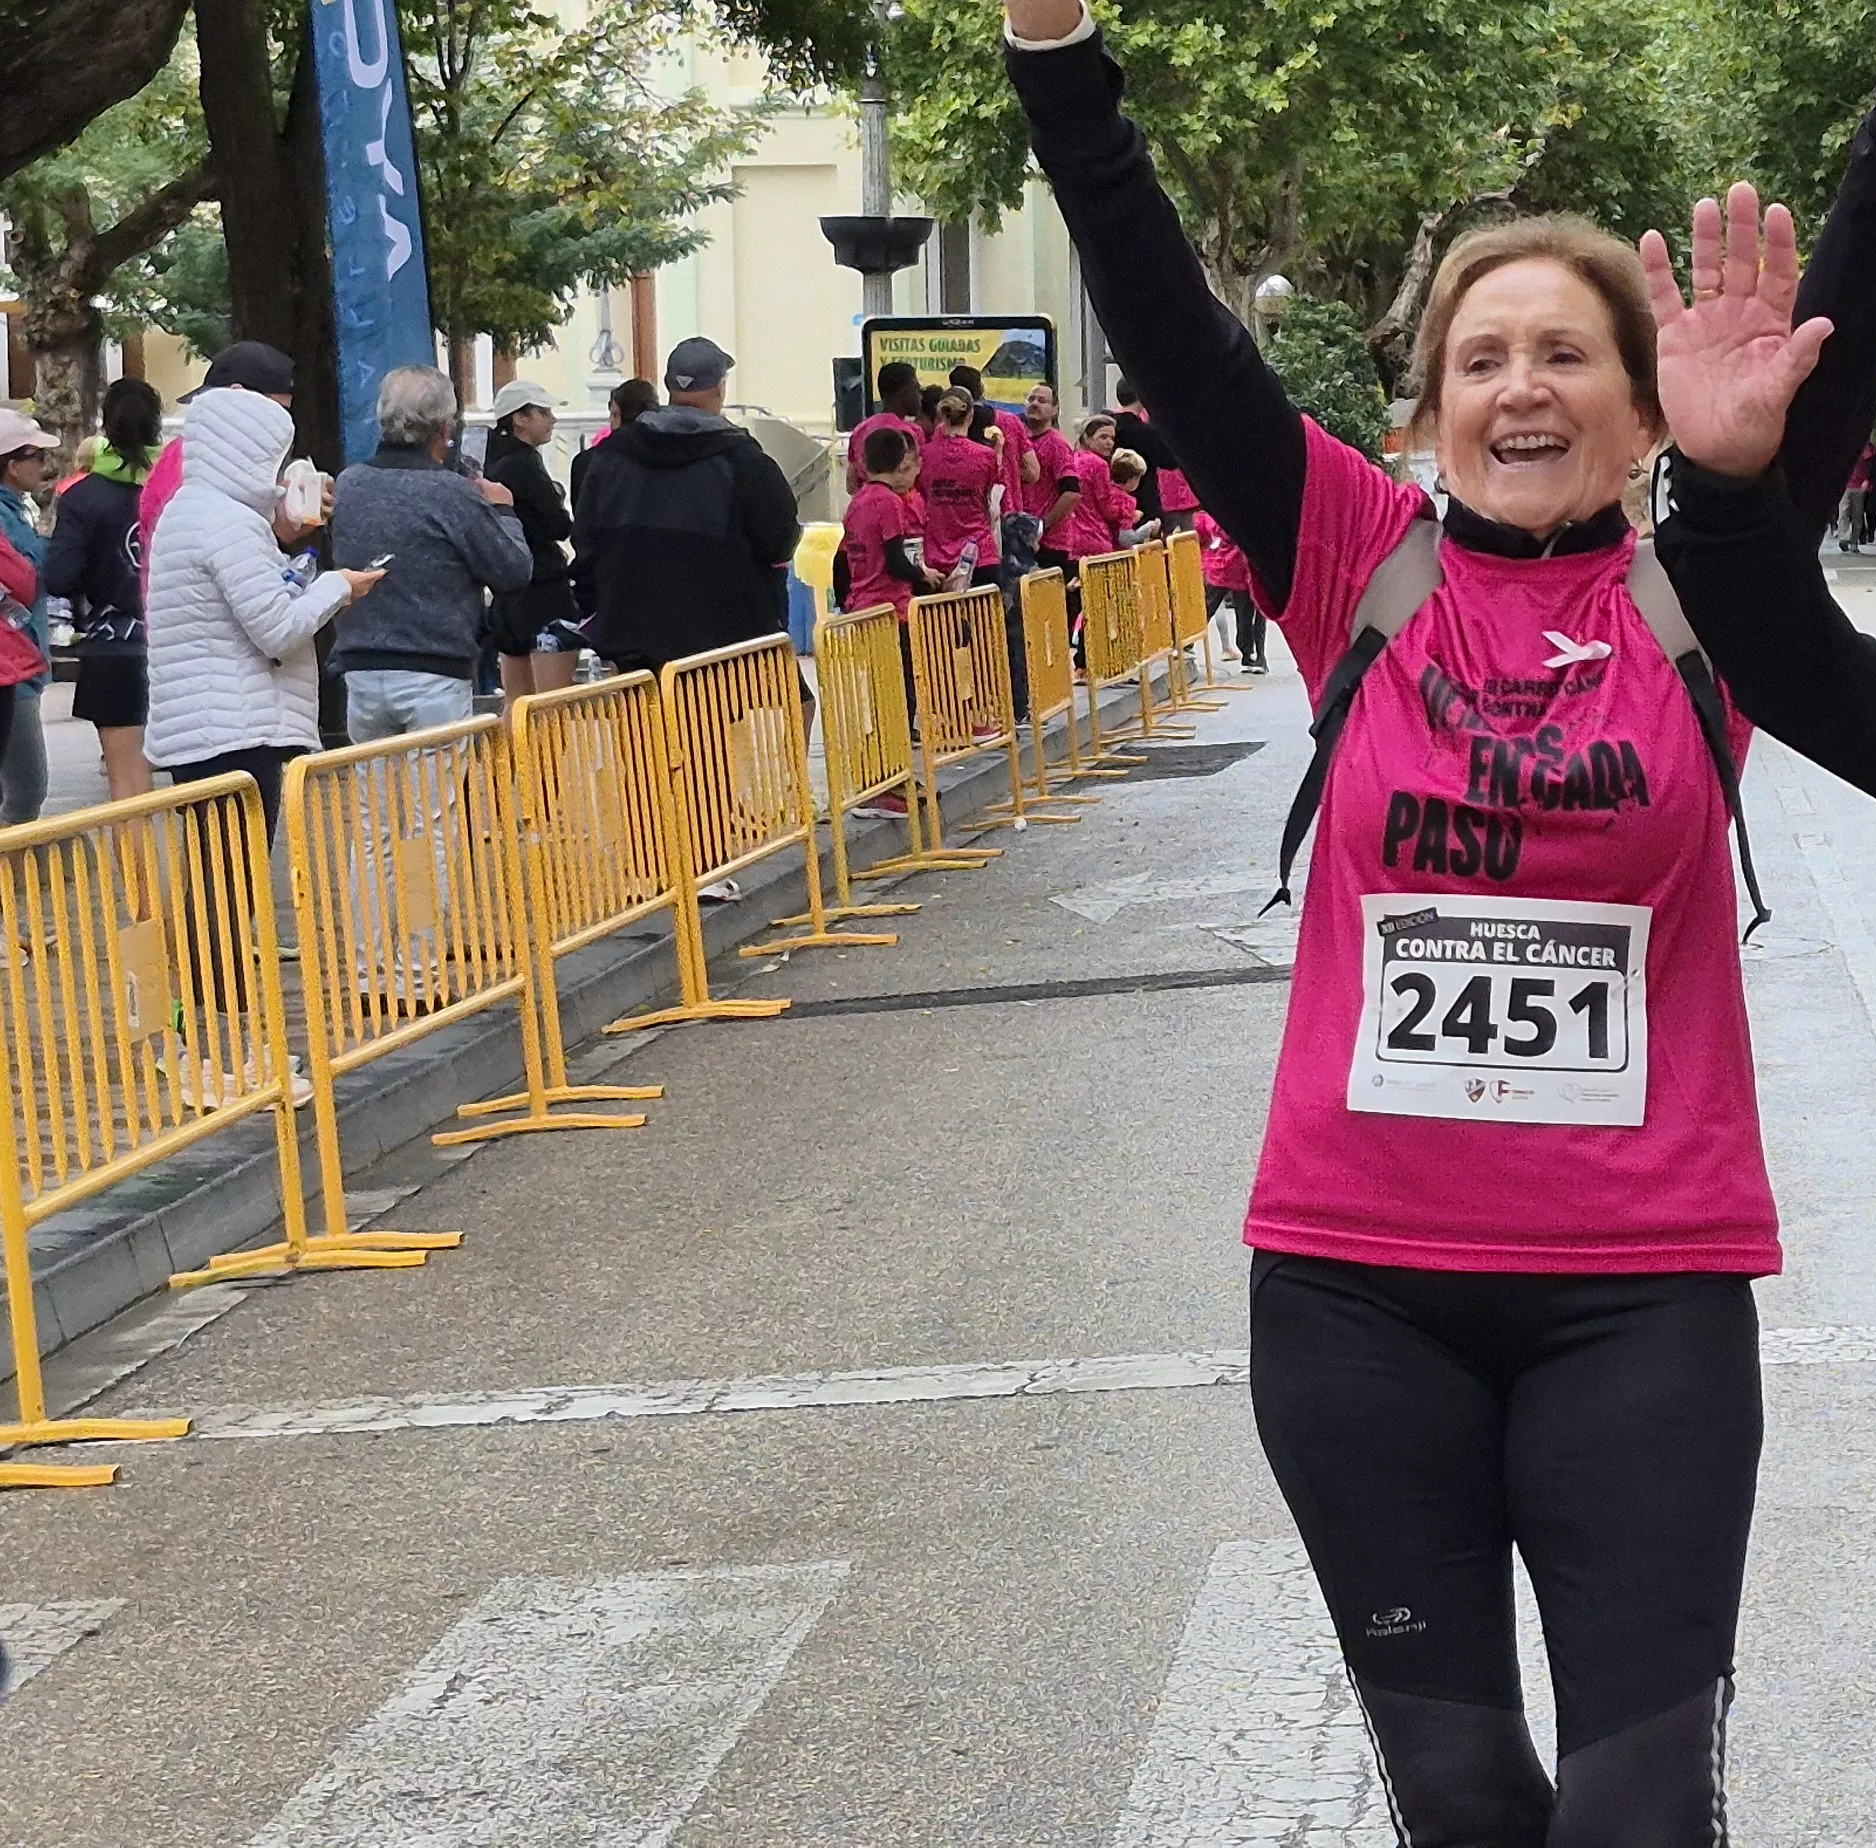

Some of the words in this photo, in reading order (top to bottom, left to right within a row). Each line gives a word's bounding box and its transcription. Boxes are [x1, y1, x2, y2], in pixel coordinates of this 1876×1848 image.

[880, 338, 925, 352] VISITAS
[929, 338, 981, 353] GUIADAS
[1383, 790, 1523, 881] PASO
[1470, 922, 1541, 940] HUESCA
[1395, 938, 1486, 960] CONTRA
[1493, 942, 1520, 962] EL
[1526, 939, 1617, 967] CÁNCER
[1387, 972, 1609, 1059] 2451
